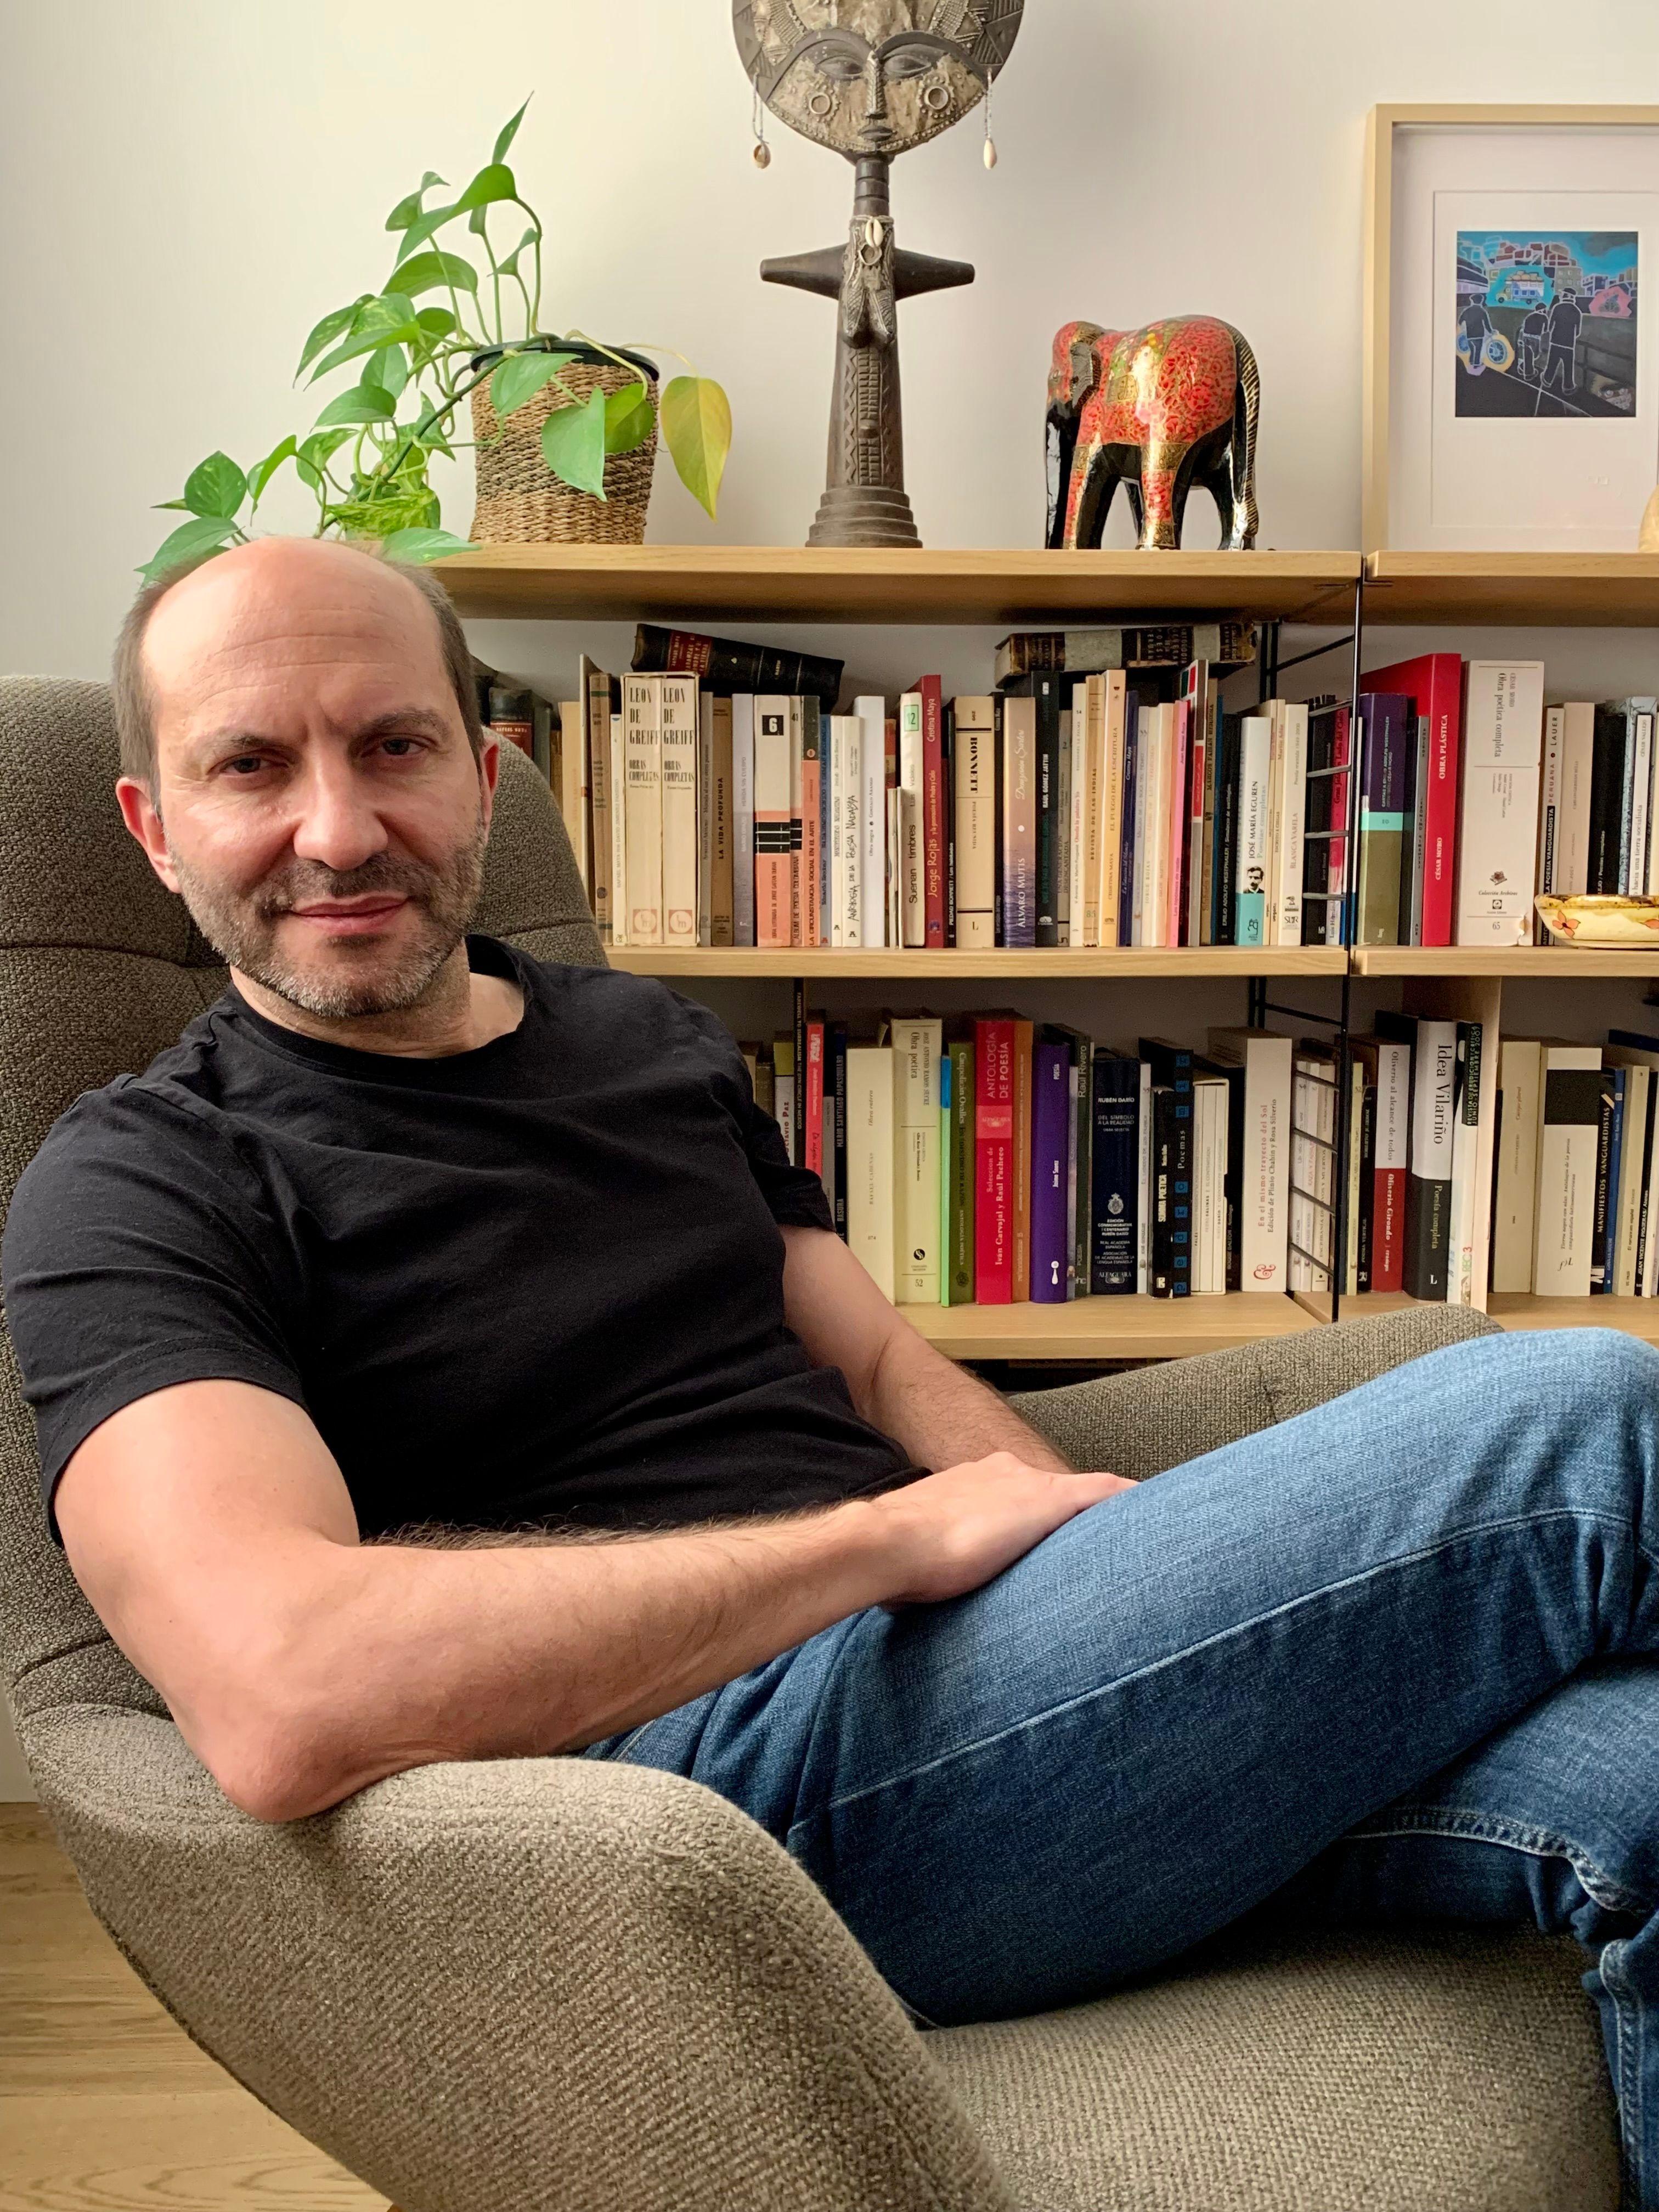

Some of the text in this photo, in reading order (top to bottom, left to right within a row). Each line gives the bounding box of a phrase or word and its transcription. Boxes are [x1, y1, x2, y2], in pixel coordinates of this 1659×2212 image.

[630, 708, 641, 724] DE
[664, 708, 675, 724] DE
[769, 717, 778, 733] 6
[907, 712, 916, 725] 12
[926, 698, 936, 742] Cristina Maya
[1492, 673, 1507, 757] Obra poética completa
[630, 730, 660, 745] GREIFF
[664, 730, 695, 745] GREIFF
[1438, 714, 1448, 754] PLÁSTICA
[1550, 716, 1558, 746] LAUER
[629, 759, 646, 770] OBRAS
[629, 771, 659, 781] COMPLETAS
[664, 760, 681, 770] OBRAS
[969, 737, 978, 794] BONNETT
[1110, 771, 1116, 781] LA
[1438, 755, 1447, 780] OBRA
[664, 772, 695, 782] COMPLETAS
[1110, 783, 1116, 794] DE
[1091, 815, 1096, 825] DE
[1110, 821, 1115, 831] EL
[809, 847, 815, 857] EN
[907, 825, 917, 859] timbres
[1248, 842, 1256, 859] JOSÉ
[718, 849, 724, 860] LA
[926, 838, 941, 898] Jorge Rojas
[1018, 857, 1026, 888] MUTIS
[909, 868, 917, 904] Suenan
[1492, 921, 1500, 930] 65
[809, 936, 815, 945] LA
[908, 1032, 921, 1079] Obra poética
[986, 1032, 996, 1098] ANTOLOGÍA
[998, 1042, 1009, 1098] DE POESÍA
[1077, 1046, 1087, 1097] Raúl Rivero
[1390, 1051, 1399, 1084] Oliverio
[1433, 1044, 1453, 1144] Idea Vilariño
[958, 1096, 967, 1124] Ovalles
[1389, 1096, 1397, 1125] alcance
[1389, 1127, 1396, 1137] de
[986, 1147, 994, 1156] de
[1177, 1130, 1186, 1169] Poemas
[1259, 1137, 1268, 1172] trayecto
[996, 1147, 1004, 1180] Pacheco
[1596, 1107, 1610, 1233] MANIFIESTOS VANGUARDISTAS
[995, 1183, 1004, 1201] Raúl
[1386, 1173, 1395, 1206] Oliverio
[1268, 1198, 1274, 1206] de
[995, 1211, 1005, 1245] Carvajal
[1258, 1217, 1265, 1227] En
[1385, 1207, 1393, 1240] Girondo
[1431, 1185, 1443, 1249] Poesía completa
[1637, 1238, 1645, 1260] VICENTE
[1430, 1274, 1437, 1284] L
